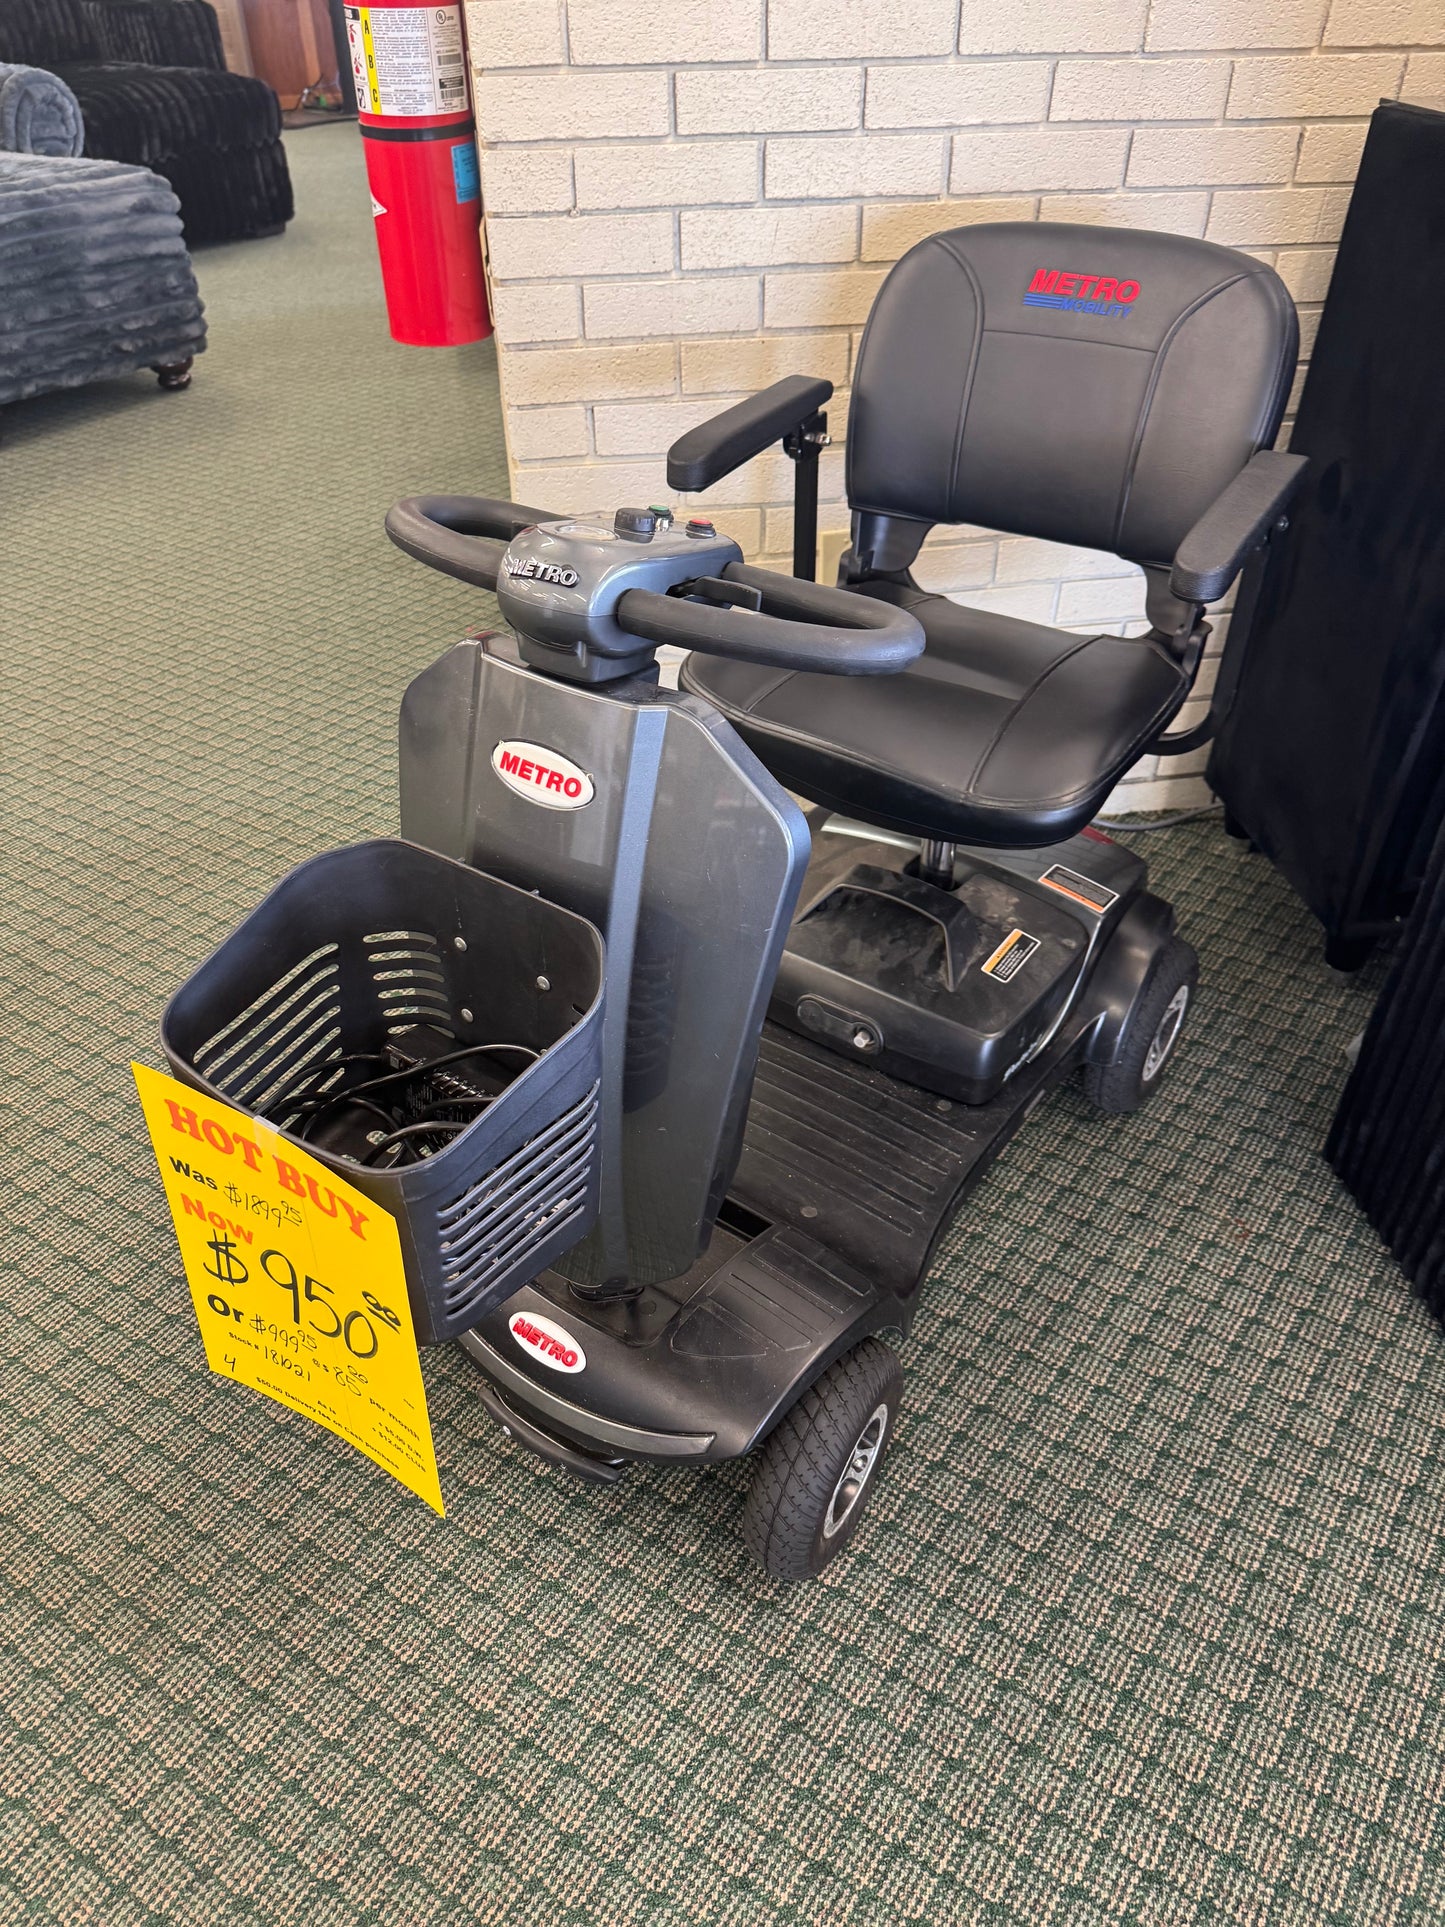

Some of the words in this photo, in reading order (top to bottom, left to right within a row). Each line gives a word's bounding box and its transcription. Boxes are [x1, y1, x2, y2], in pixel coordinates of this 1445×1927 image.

[364, 19, 370, 35] A
[368, 54, 374, 69] B
[372, 88, 378, 103] C
[1027, 268, 1141, 304] METRO
[1059, 297, 1134, 319] MOBILITY
[508, 558, 580, 588] METRO
[499, 750, 582, 798] METRO
[164, 1098, 263, 1172] HOT
[272, 1154, 370, 1241] BUY
[169, 1155, 218, 1191] Was
[228, 1331, 253, 1348] Stock
[512, 1317, 578, 1367] METRO
[207, 1293, 244, 1323] Or
[369, 1397, 386, 1412] per
[388, 1412, 420, 1441] month
[223, 1353, 236, 1373] 4
[284, 1391, 317, 1413] Delivery
[365, 1441, 400, 1470] purchase
